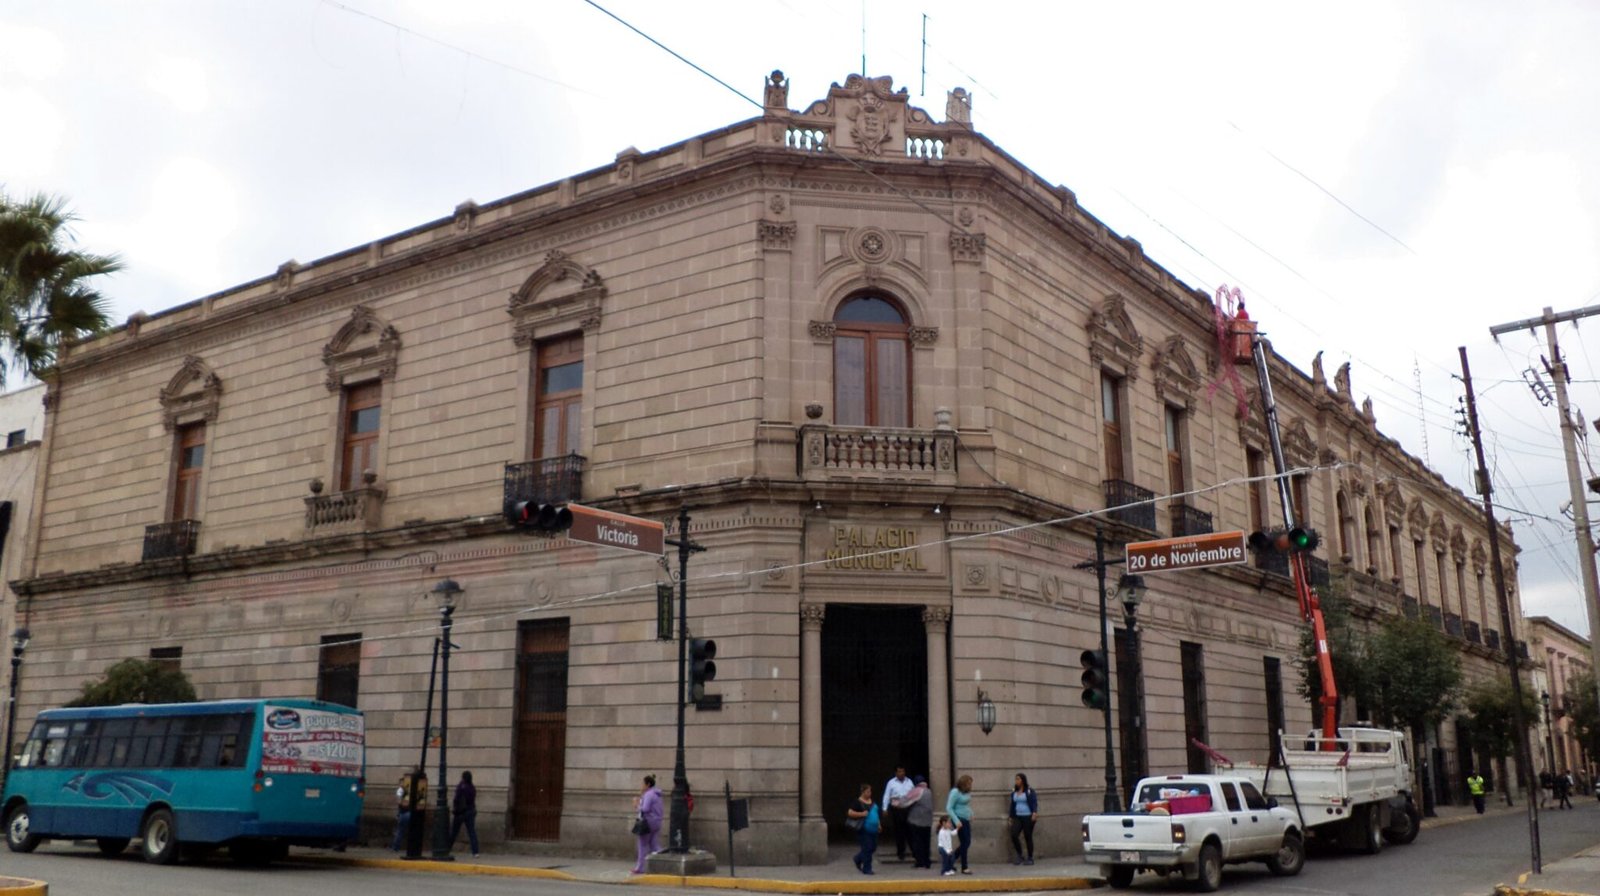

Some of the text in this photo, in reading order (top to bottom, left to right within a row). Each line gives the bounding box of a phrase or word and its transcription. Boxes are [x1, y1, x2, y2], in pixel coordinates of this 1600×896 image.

[597, 524, 638, 546] Victoria
[835, 527, 917, 548] PALACIO
[825, 549, 927, 571] MUNICIPAL
[1131, 546, 1241, 569] 20 de Noviembre
